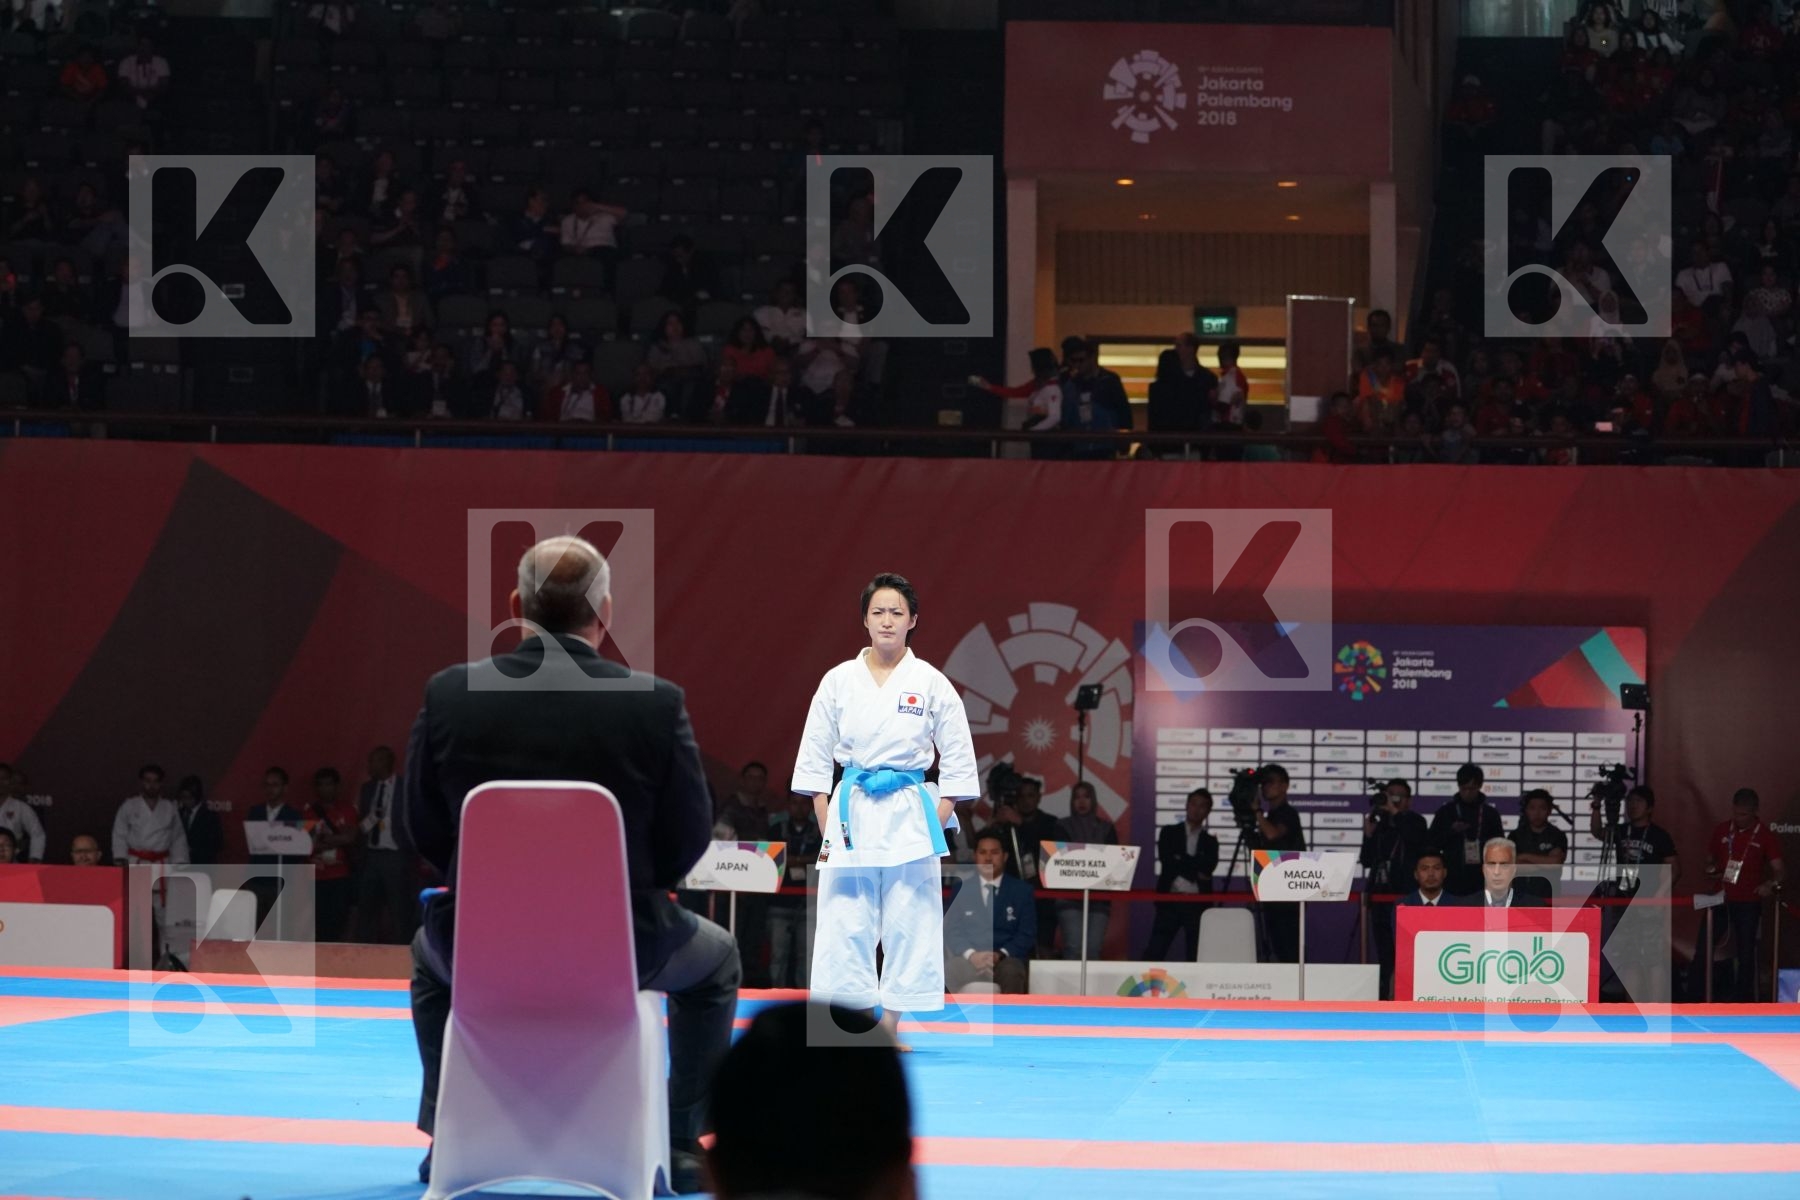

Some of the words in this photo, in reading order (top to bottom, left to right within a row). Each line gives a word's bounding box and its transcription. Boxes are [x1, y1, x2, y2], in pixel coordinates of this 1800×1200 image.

[1198, 76, 1264, 90] Jakarta
[1198, 92, 1293, 112] Palembang
[1198, 110, 1237, 125] 2018
[1203, 318, 1228, 333] EXIT
[1393, 657, 1435, 667] Jakarta
[1392, 668, 1453, 680] Palembang
[1392, 679, 1418, 689] 2018
[899, 705, 923, 716] JAPAN
[715, 862, 748, 871] JAPAN
[1054, 859, 1086, 868] WOMEN'S
[1088, 860, 1106, 868] KATA
[1059, 869, 1100, 878] INDIVIDUAL
[1284, 870, 1325, 880] MACAU,
[1288, 881, 1321, 890] CHINA
[1438, 936, 1565, 985] Grab
